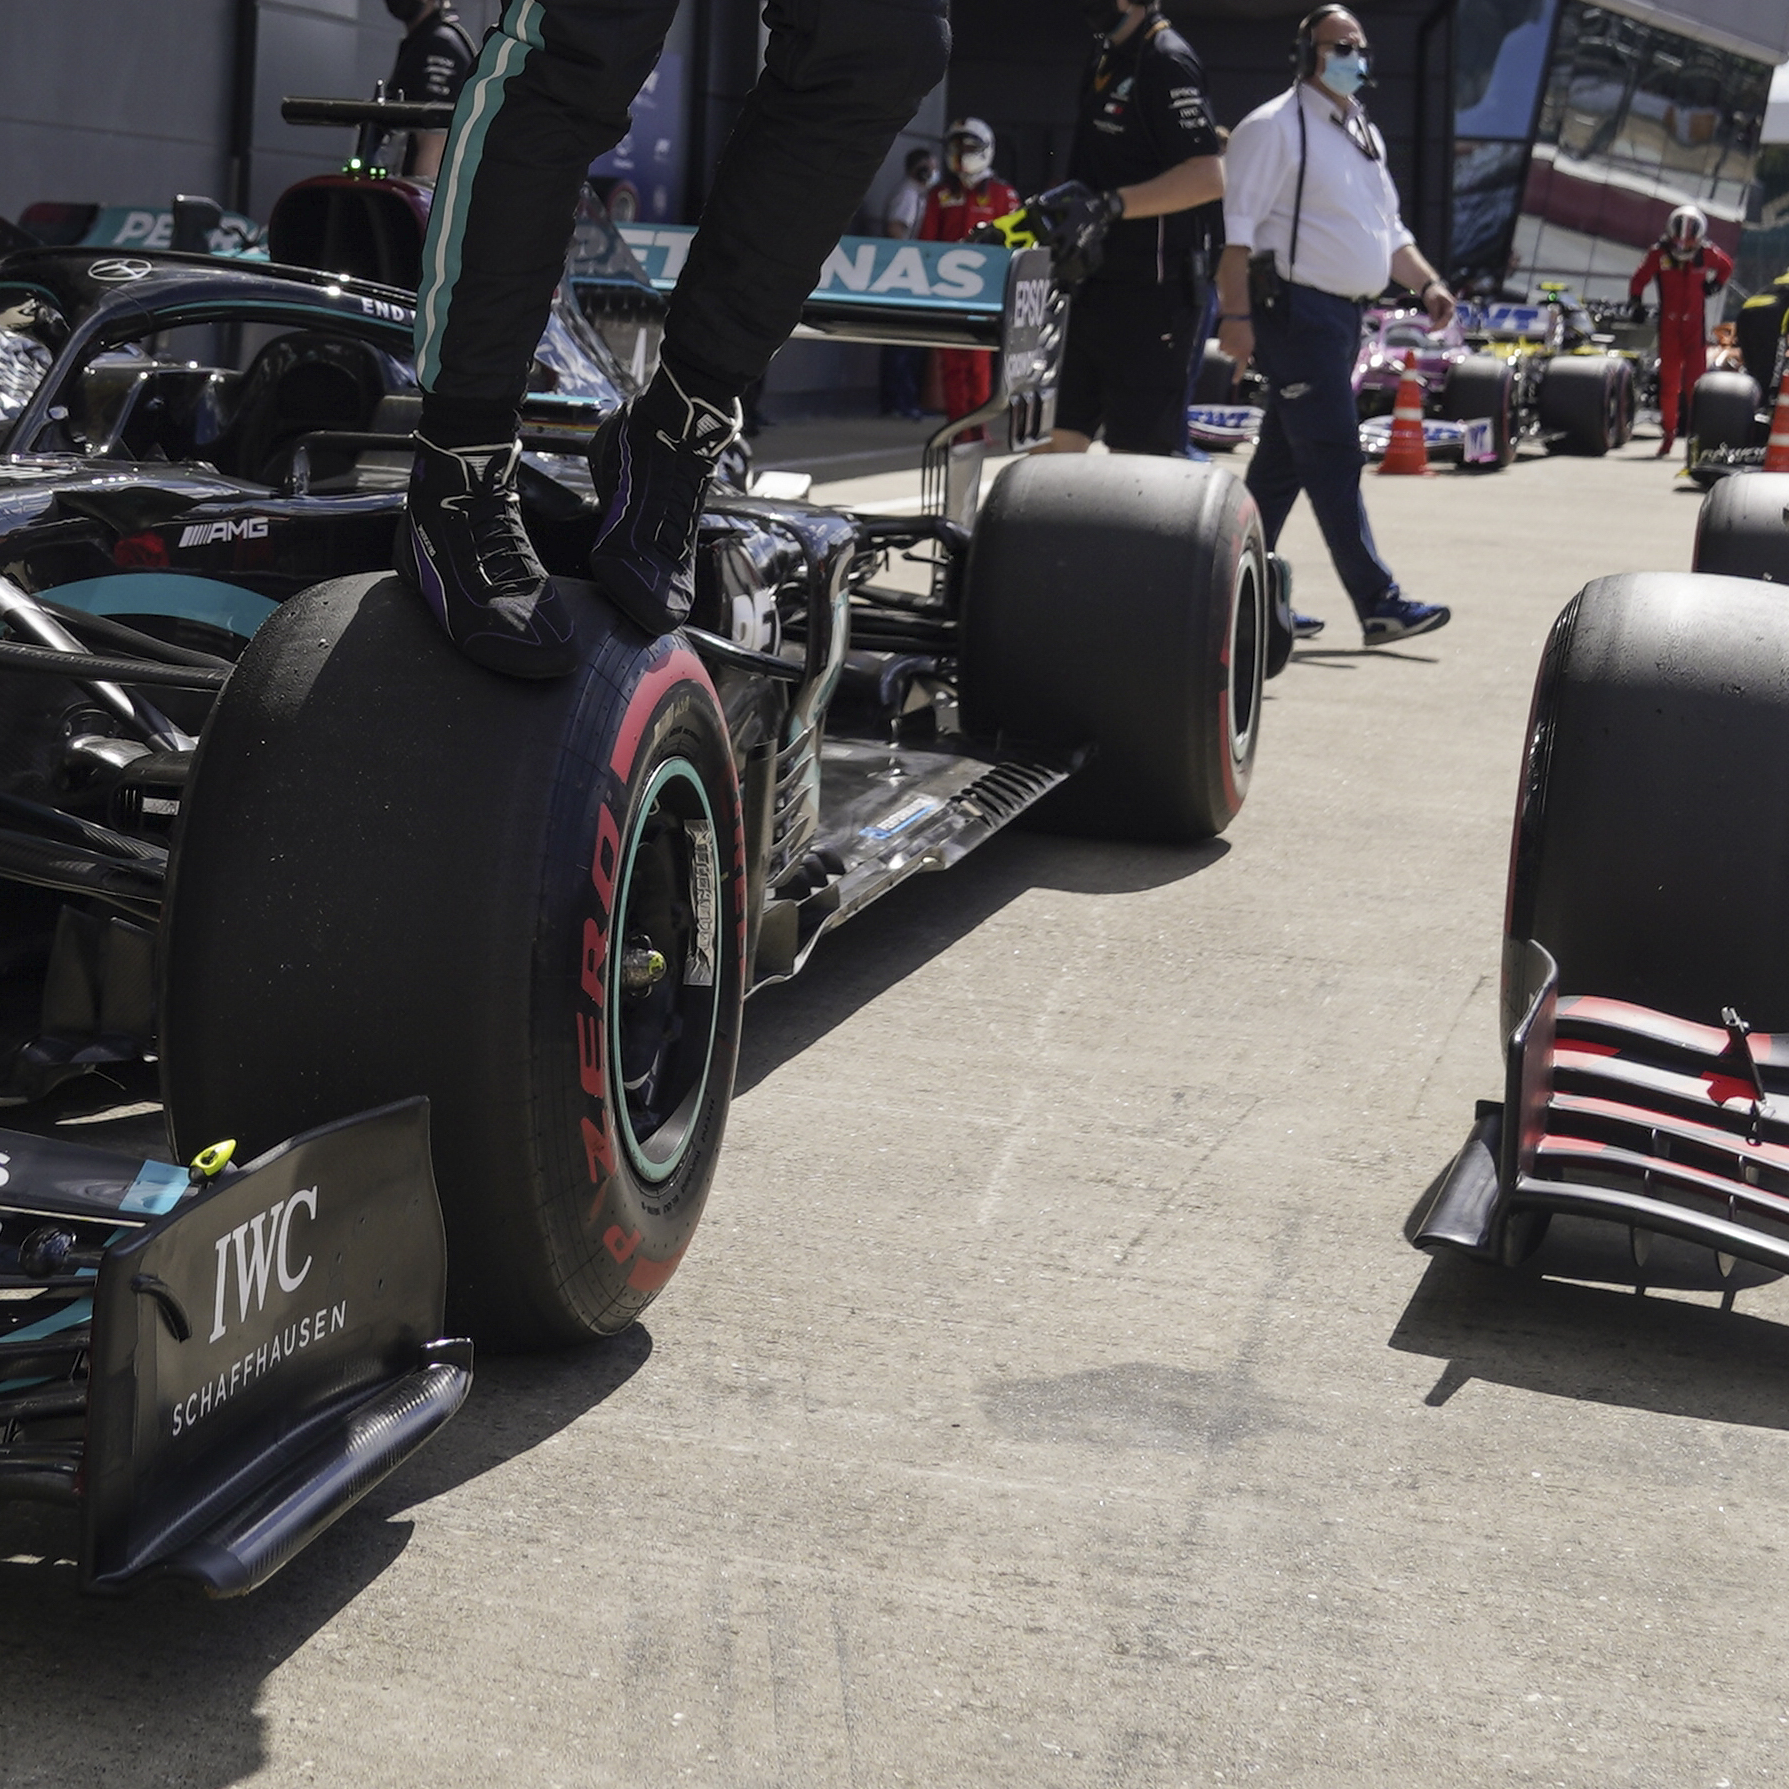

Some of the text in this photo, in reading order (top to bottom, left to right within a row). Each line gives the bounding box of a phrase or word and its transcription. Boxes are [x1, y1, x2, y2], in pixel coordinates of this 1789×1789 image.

[361, 296, 405, 322] END
[208, 1183, 319, 1344] IWC
[171, 1299, 349, 1438] SCHAFFHAUSEN
